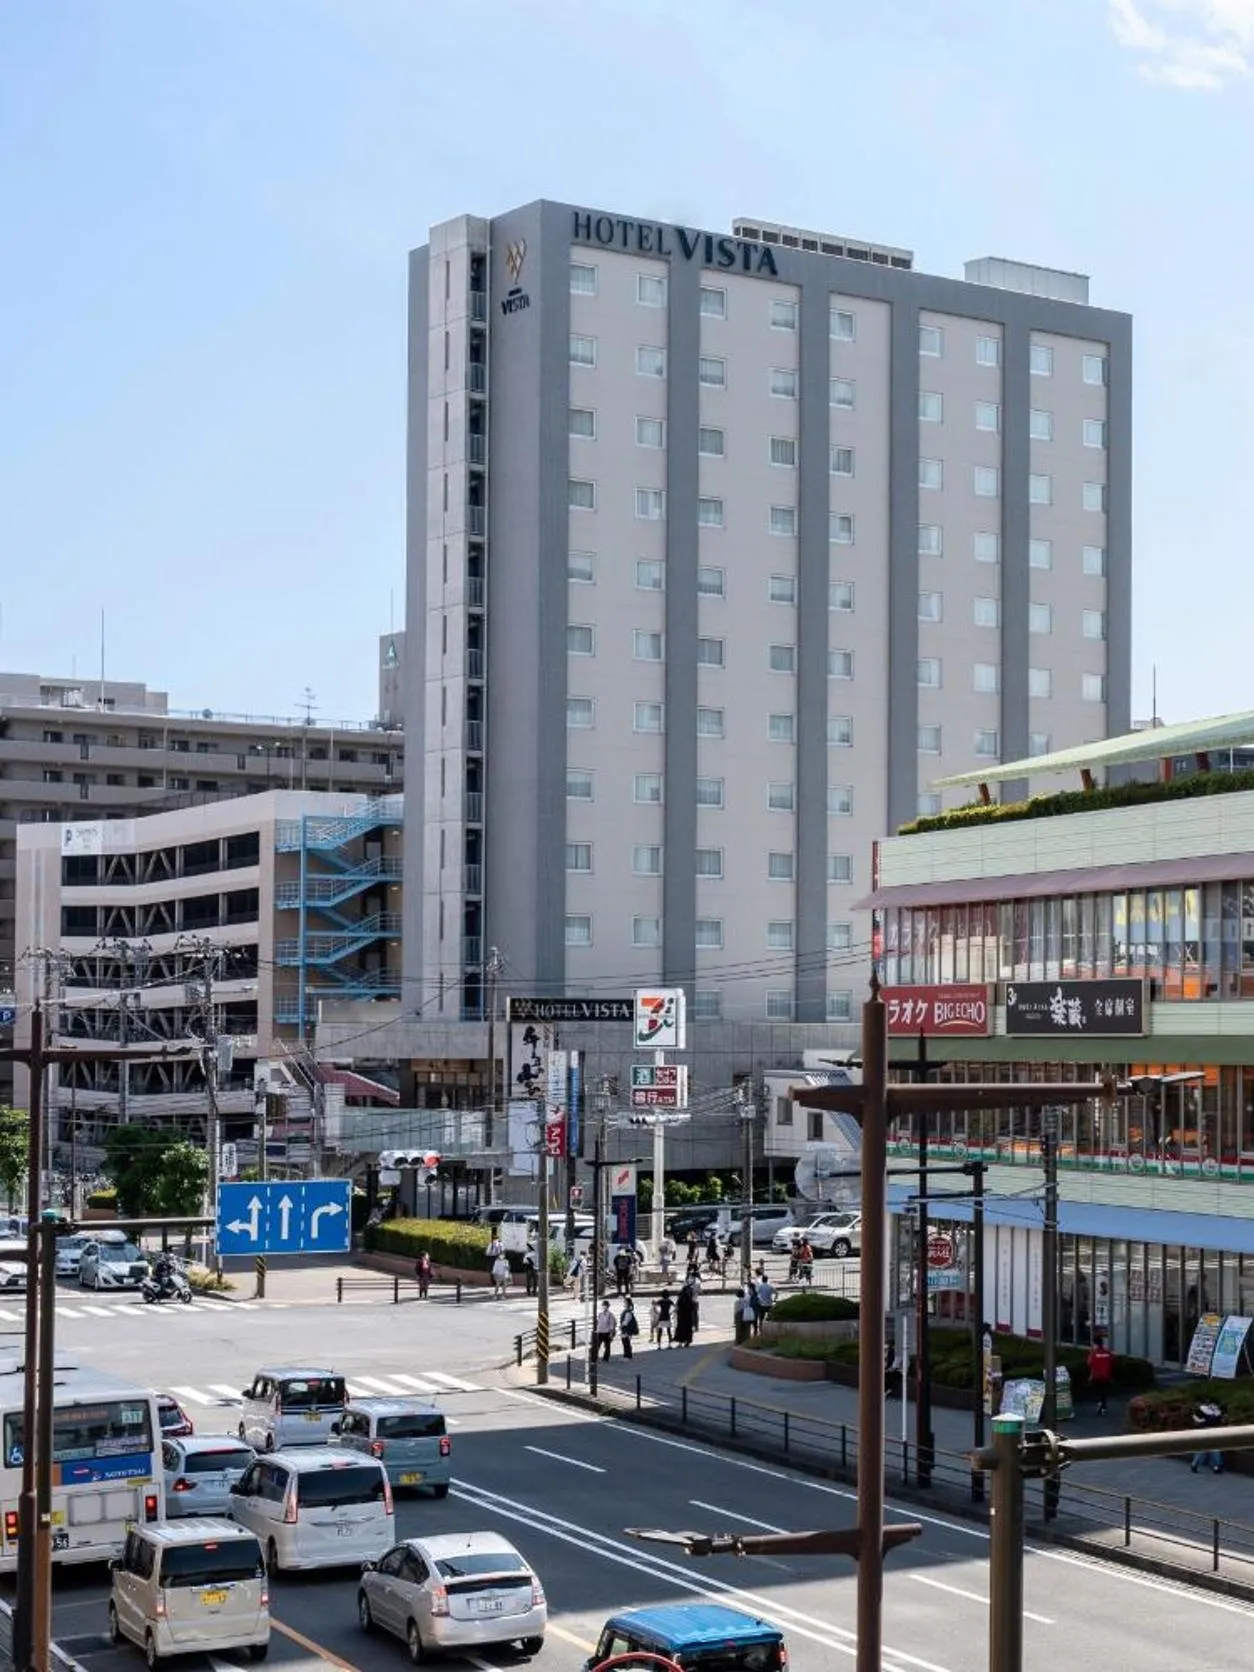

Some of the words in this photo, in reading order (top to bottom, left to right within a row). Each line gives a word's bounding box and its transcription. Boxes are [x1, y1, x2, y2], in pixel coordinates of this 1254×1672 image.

[573, 211, 671, 256] HOTEL
[676, 226, 778, 276] VISTA
[501, 294, 530, 315] VISTA
[535, 1003, 580, 1018] HOTEL
[580, 1001, 630, 1018] VISTA
[889, 999, 929, 1025] ラオケ
[934, 1000, 954, 1025] BIG
[955, 1000, 986, 1025] ECHO
[1049, 987, 1082, 1029] 楽蔵
[636, 1067, 652, 1085] 酒
